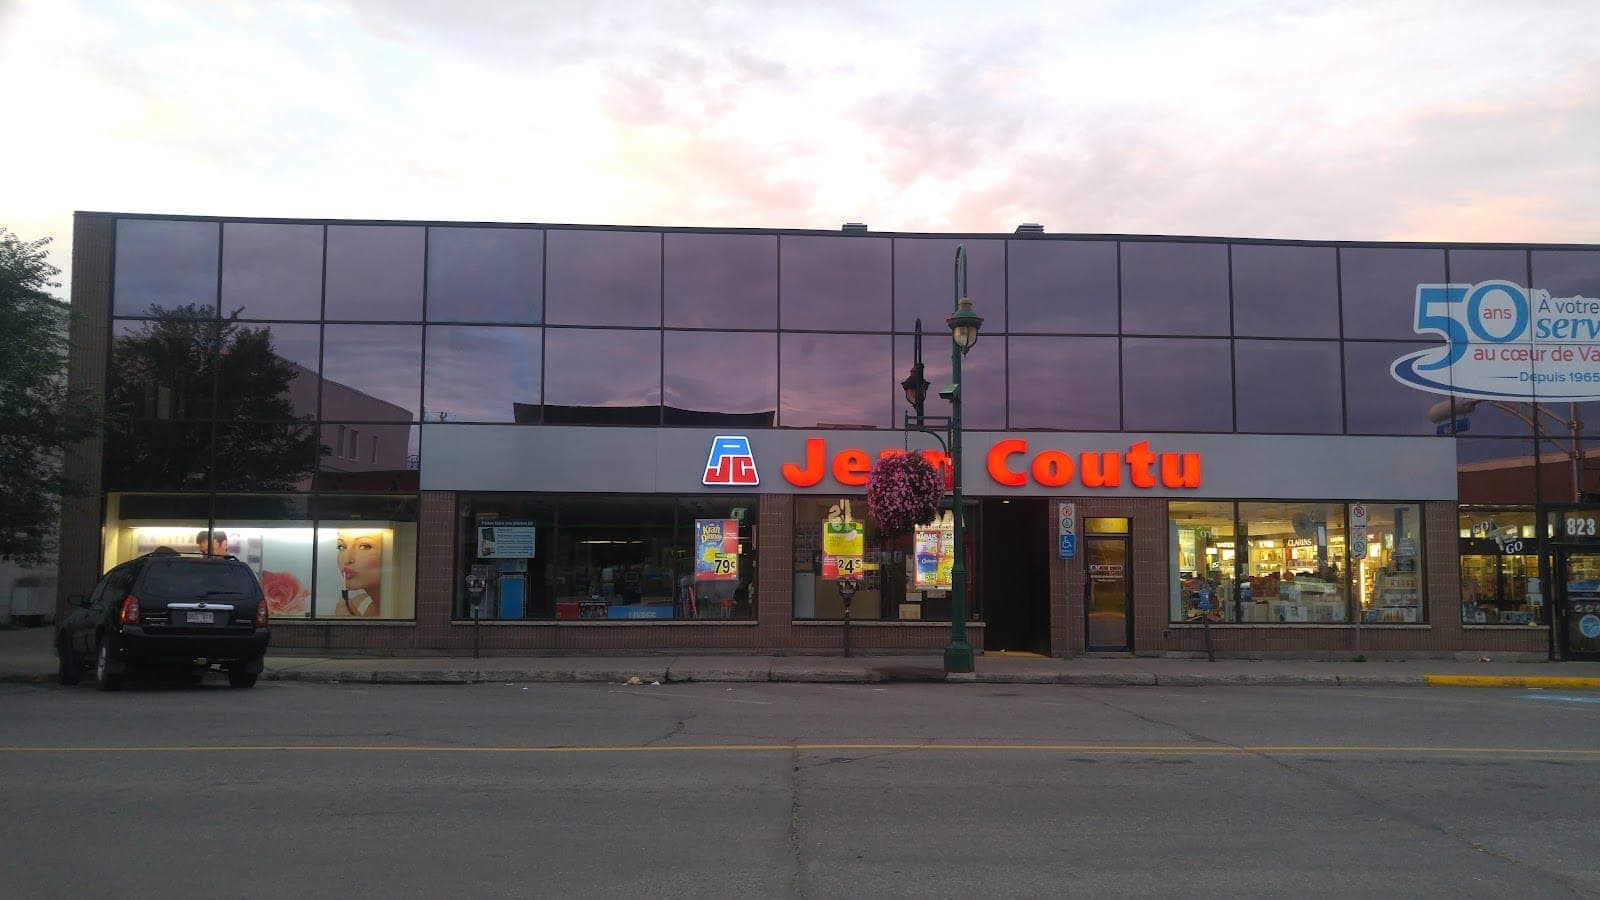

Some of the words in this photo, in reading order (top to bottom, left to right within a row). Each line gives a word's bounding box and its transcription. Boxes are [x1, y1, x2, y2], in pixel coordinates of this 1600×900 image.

[1538, 294, 1550, 314] À
[1555, 300, 1600, 314] votre
[1417, 284, 1529, 370] 50
[1483, 307, 1512, 320] ans
[1473, 349, 1495, 361] au
[1500, 349, 1547, 362] cœur
[1551, 346, 1574, 362] de
[1577, 346, 1600, 362] Va
[1519, 372, 1566, 384] Depuis
[1569, 372, 1600, 382] 1965
[780, 438, 954, 492] Jen
[987, 439, 1202, 488] Coutu
[1566, 518, 1596, 536] 823
[1287, 538, 1313, 547] CLARINS
[1505, 540, 1523, 554] GO
